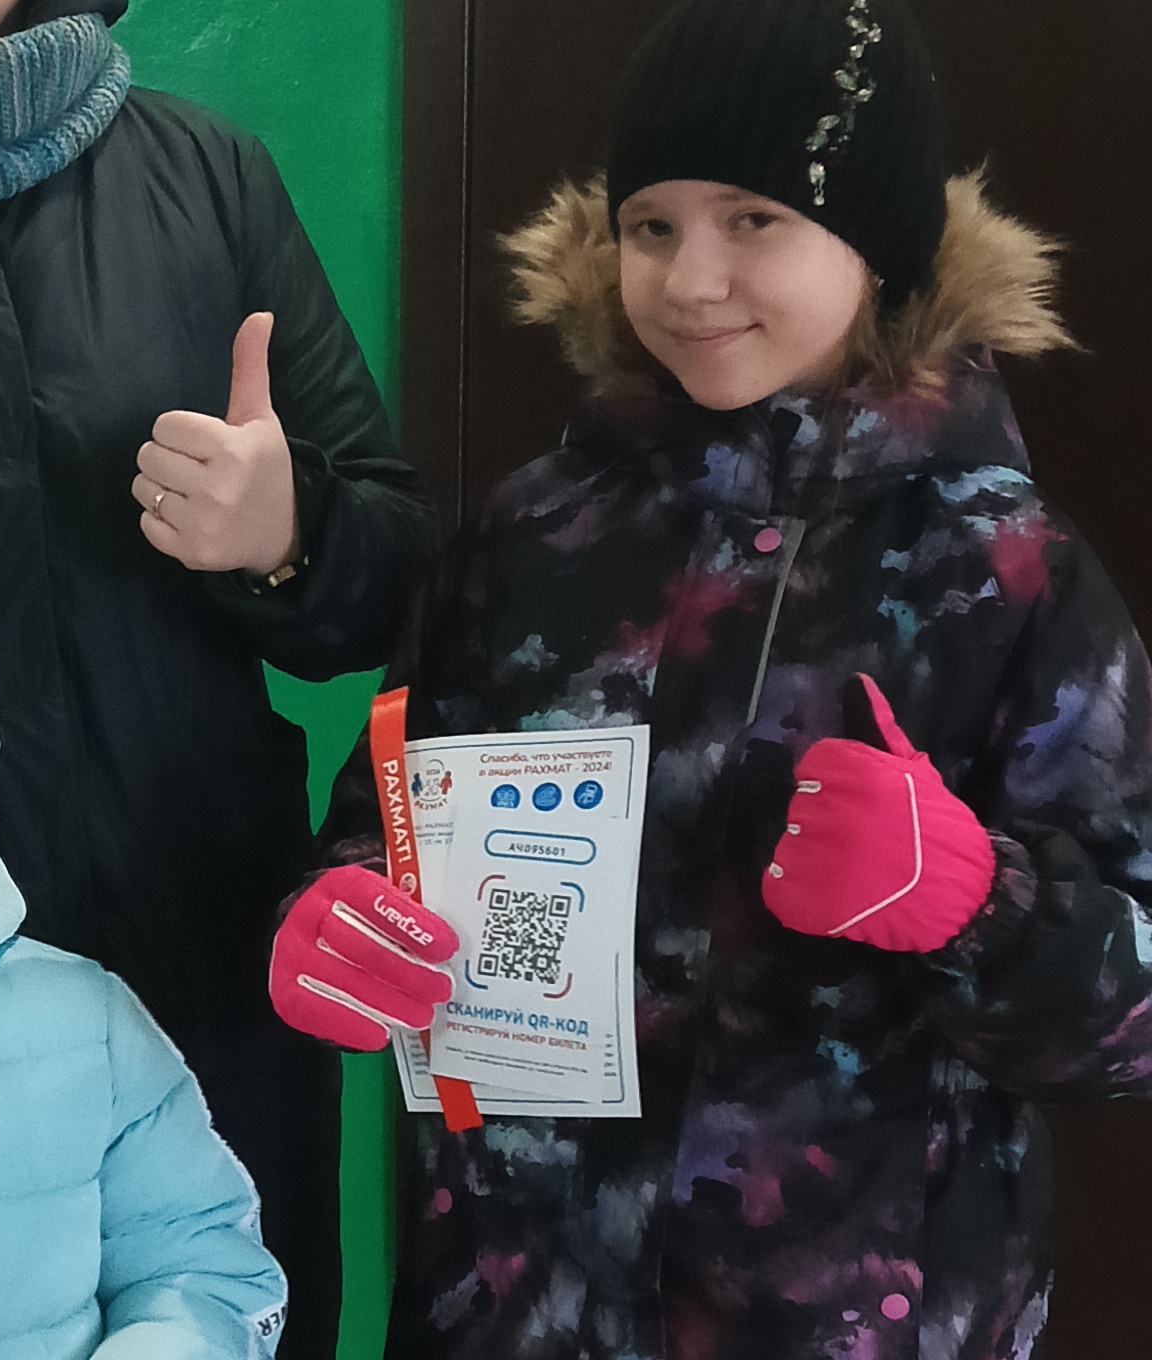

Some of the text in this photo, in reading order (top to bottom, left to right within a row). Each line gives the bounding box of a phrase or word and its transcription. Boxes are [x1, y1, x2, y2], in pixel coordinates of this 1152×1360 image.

[532, 753, 550, 763] что
[524, 763, 571, 775] РАХМАТ
[382, 759, 413, 864] РАХМАТ!
[445, 1001, 590, 1037] СКАНИРУЙ QR-КОД
[512, 1033, 547, 1045] НОМЕР
[548, 1038, 588, 1051] БИЛЕТА
